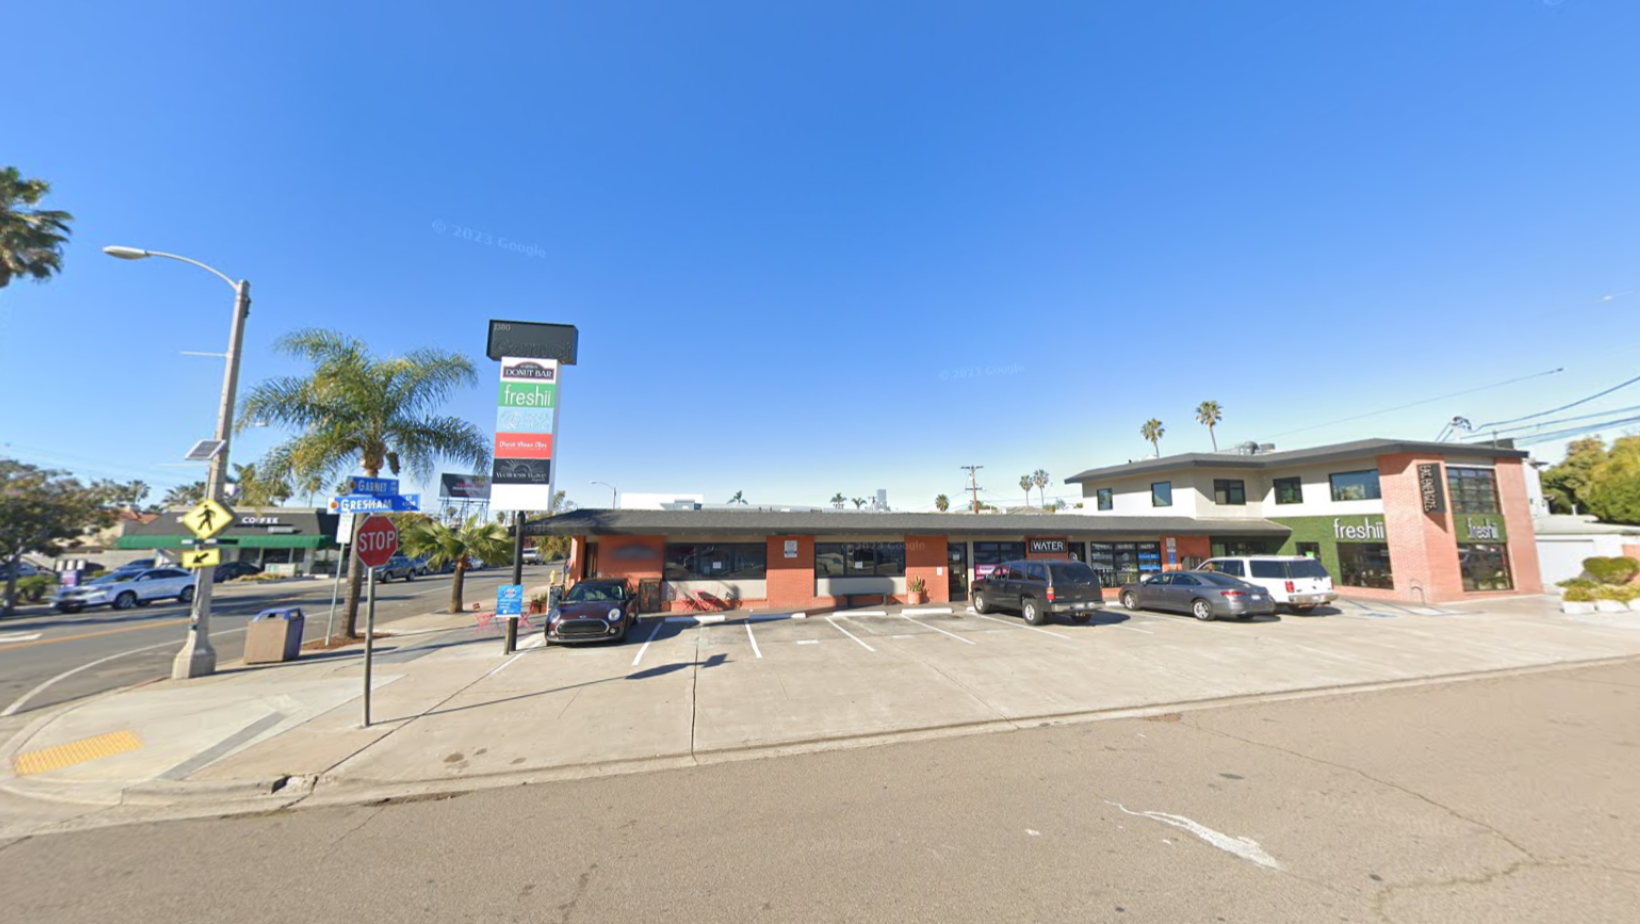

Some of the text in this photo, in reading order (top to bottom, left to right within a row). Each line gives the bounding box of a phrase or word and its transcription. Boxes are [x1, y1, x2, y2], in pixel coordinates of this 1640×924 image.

[505, 368, 552, 378] DONUT BAR
[504, 384, 552, 407] freshii
[358, 480, 387, 492] GARNET
[341, 498, 393, 511] GRESHAM
[1333, 517, 1385, 539] freshii
[358, 531, 395, 552] STOP
[1032, 541, 1064, 550] WATER
